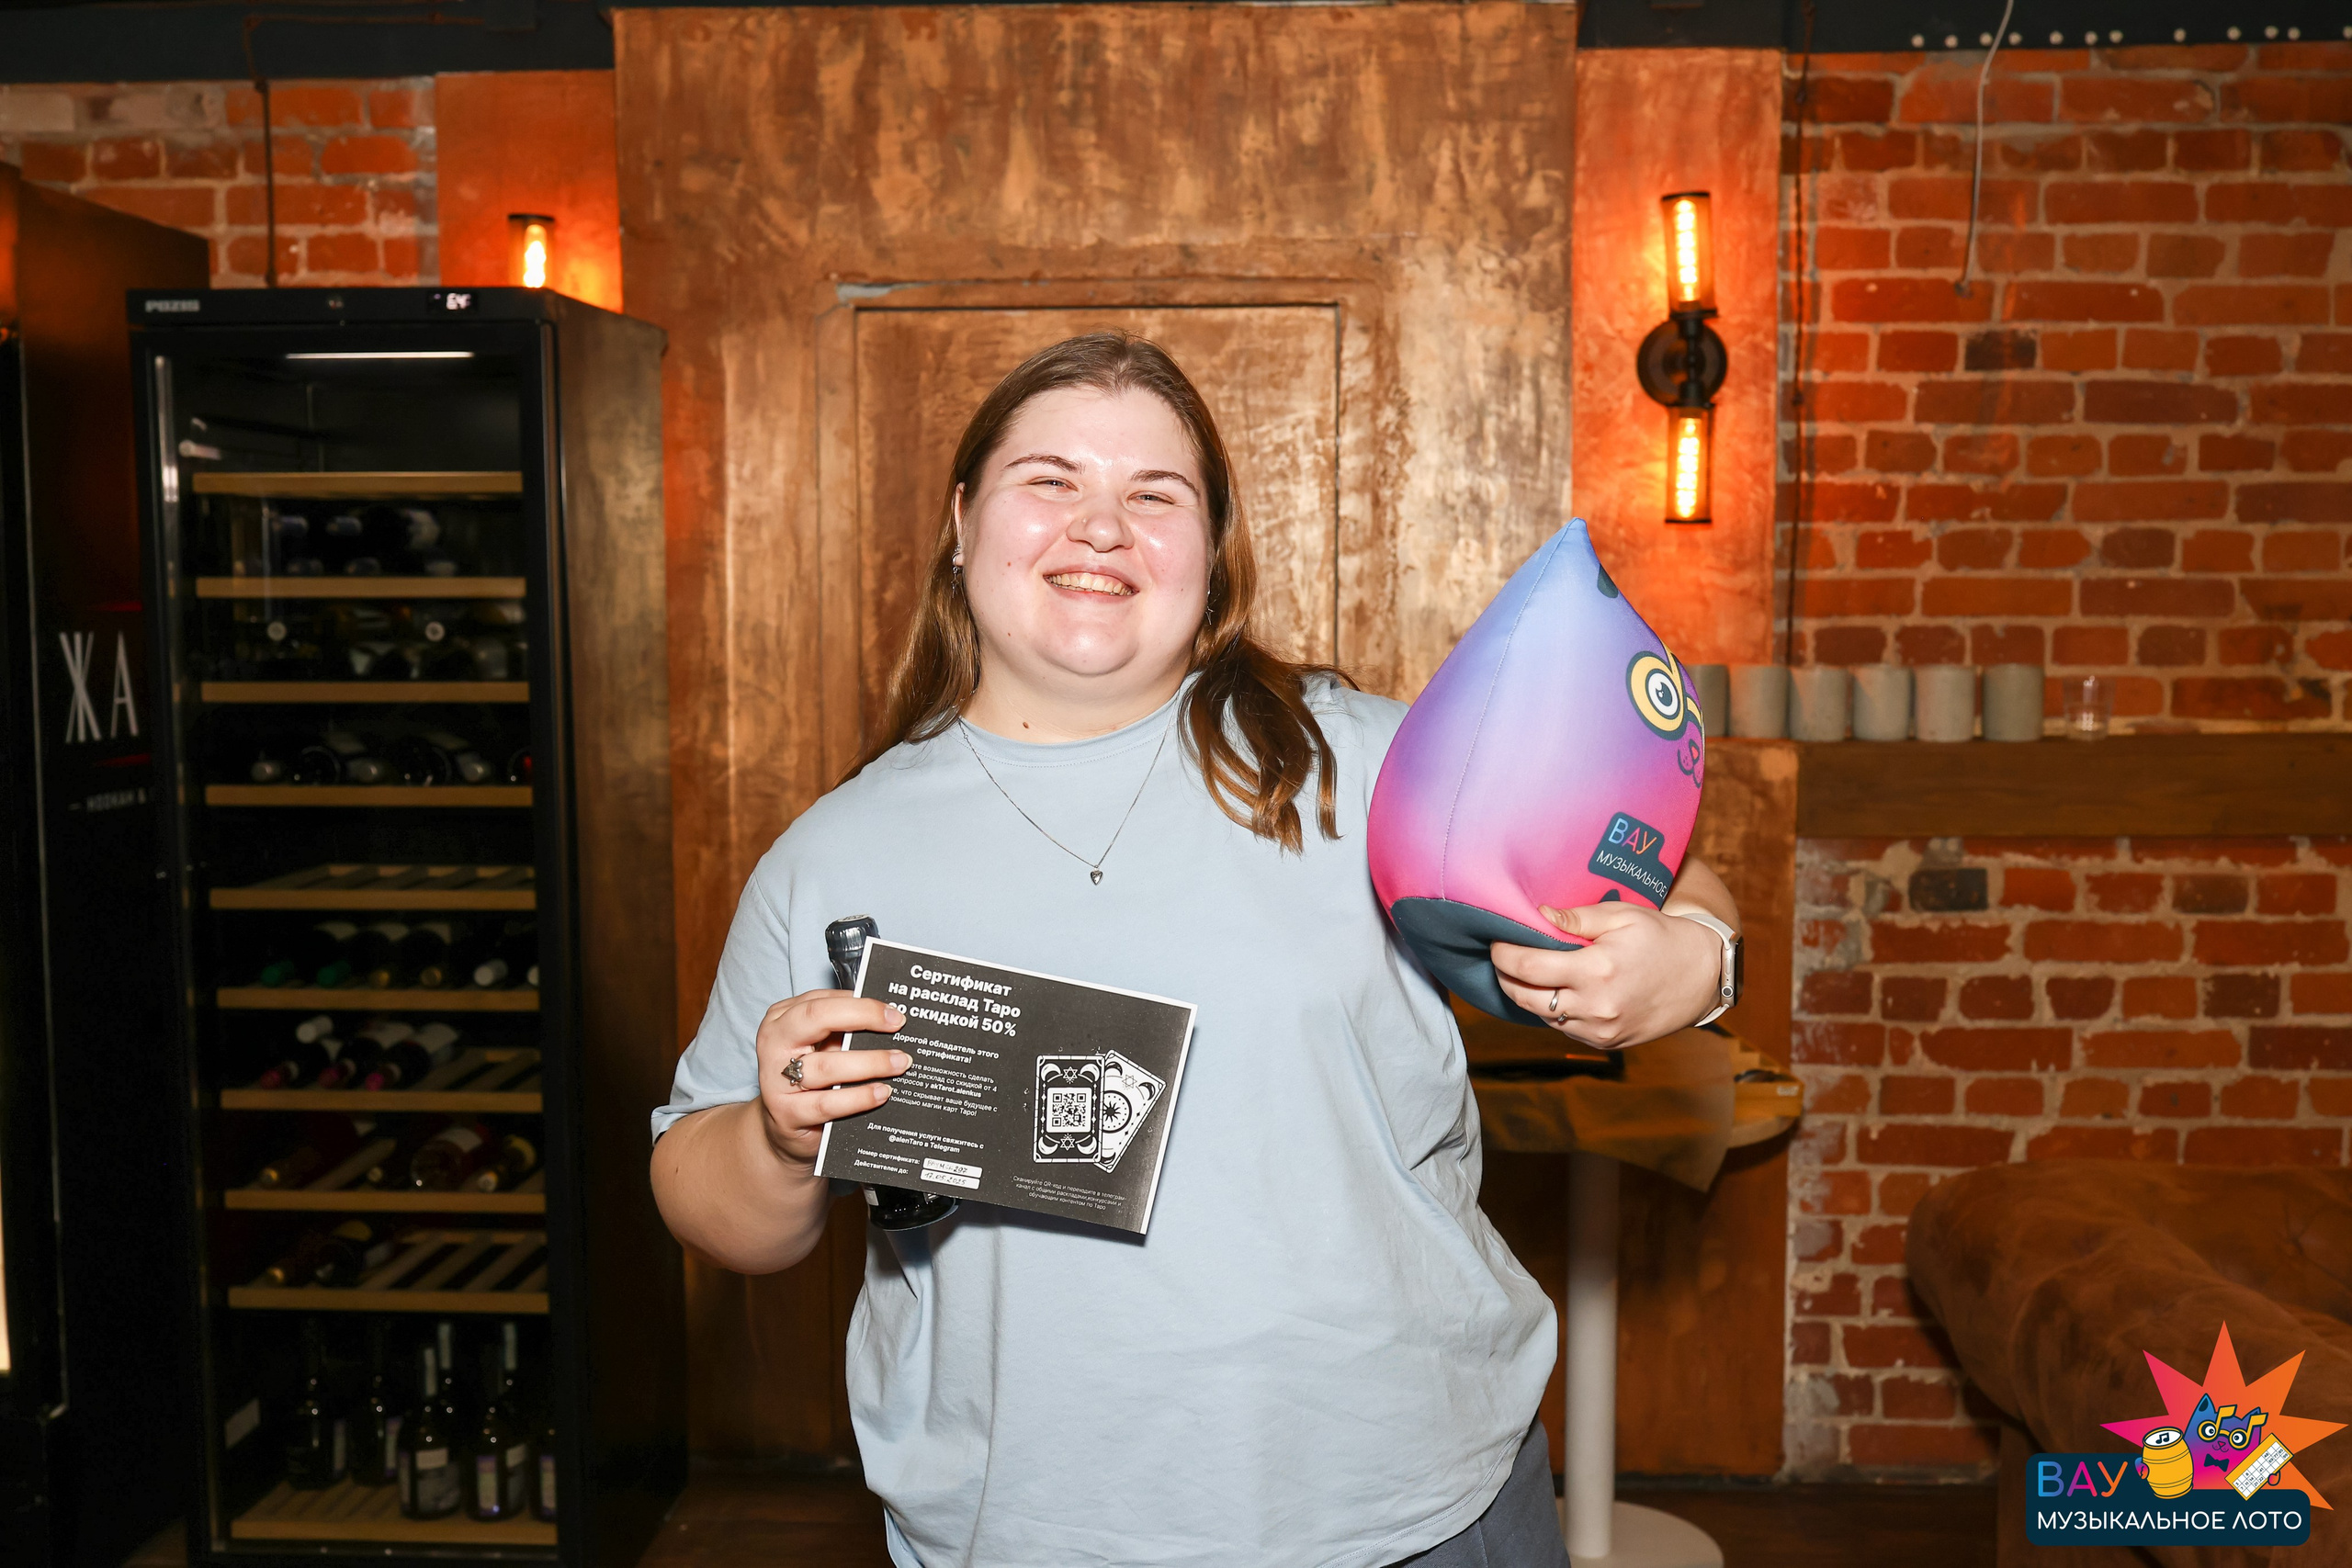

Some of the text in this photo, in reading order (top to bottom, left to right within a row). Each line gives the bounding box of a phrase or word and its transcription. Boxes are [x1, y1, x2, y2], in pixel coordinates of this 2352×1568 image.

[1608, 818, 1657, 855] ВАУ
[1596, 850, 1668, 898] МУЗЫКАЛЬНОЕ
[910, 964, 1012, 997] Сертификат
[888, 982, 1021, 1019] на расклад Таро
[910, 1006, 979, 1030] скидкой
[981, 1018, 1017, 1037] 50%
[893, 1032, 1000, 1059] Дорогой обладатель этого
[917, 1048, 972, 1064] сертификата!
[918, 1073, 945, 1084] расклад
[956, 1080, 983, 1090] скидкой
[922, 1066, 967, 1078] возможность
[967, 1074, 994, 1084] сделать
[930, 1083, 982, 1098] akTarot.alenkus
[912, 1091, 945, 1102] скрывает
[945, 1097, 963, 1106] ваше
[963, 1100, 992, 1111] будущее
[922, 1101, 943, 1110] магии
[943, 1105, 958, 1113] карт
[959, 1107, 978, 1117] Таро!
[867, 1122, 882, 1131] Для
[882, 1126, 918, 1138] получения
[919, 1132, 942, 1142] услуги
[942, 1136, 978, 1148] свяжитесь
[857, 1148, 921, 1165] Номер сертификата:
[930, 1143, 961, 1154] Telegram
[854, 1159, 899, 1173] Действителен
[1015, 1183, 1031, 1191] канал
[1094, 1202, 1106, 1211] Таро
